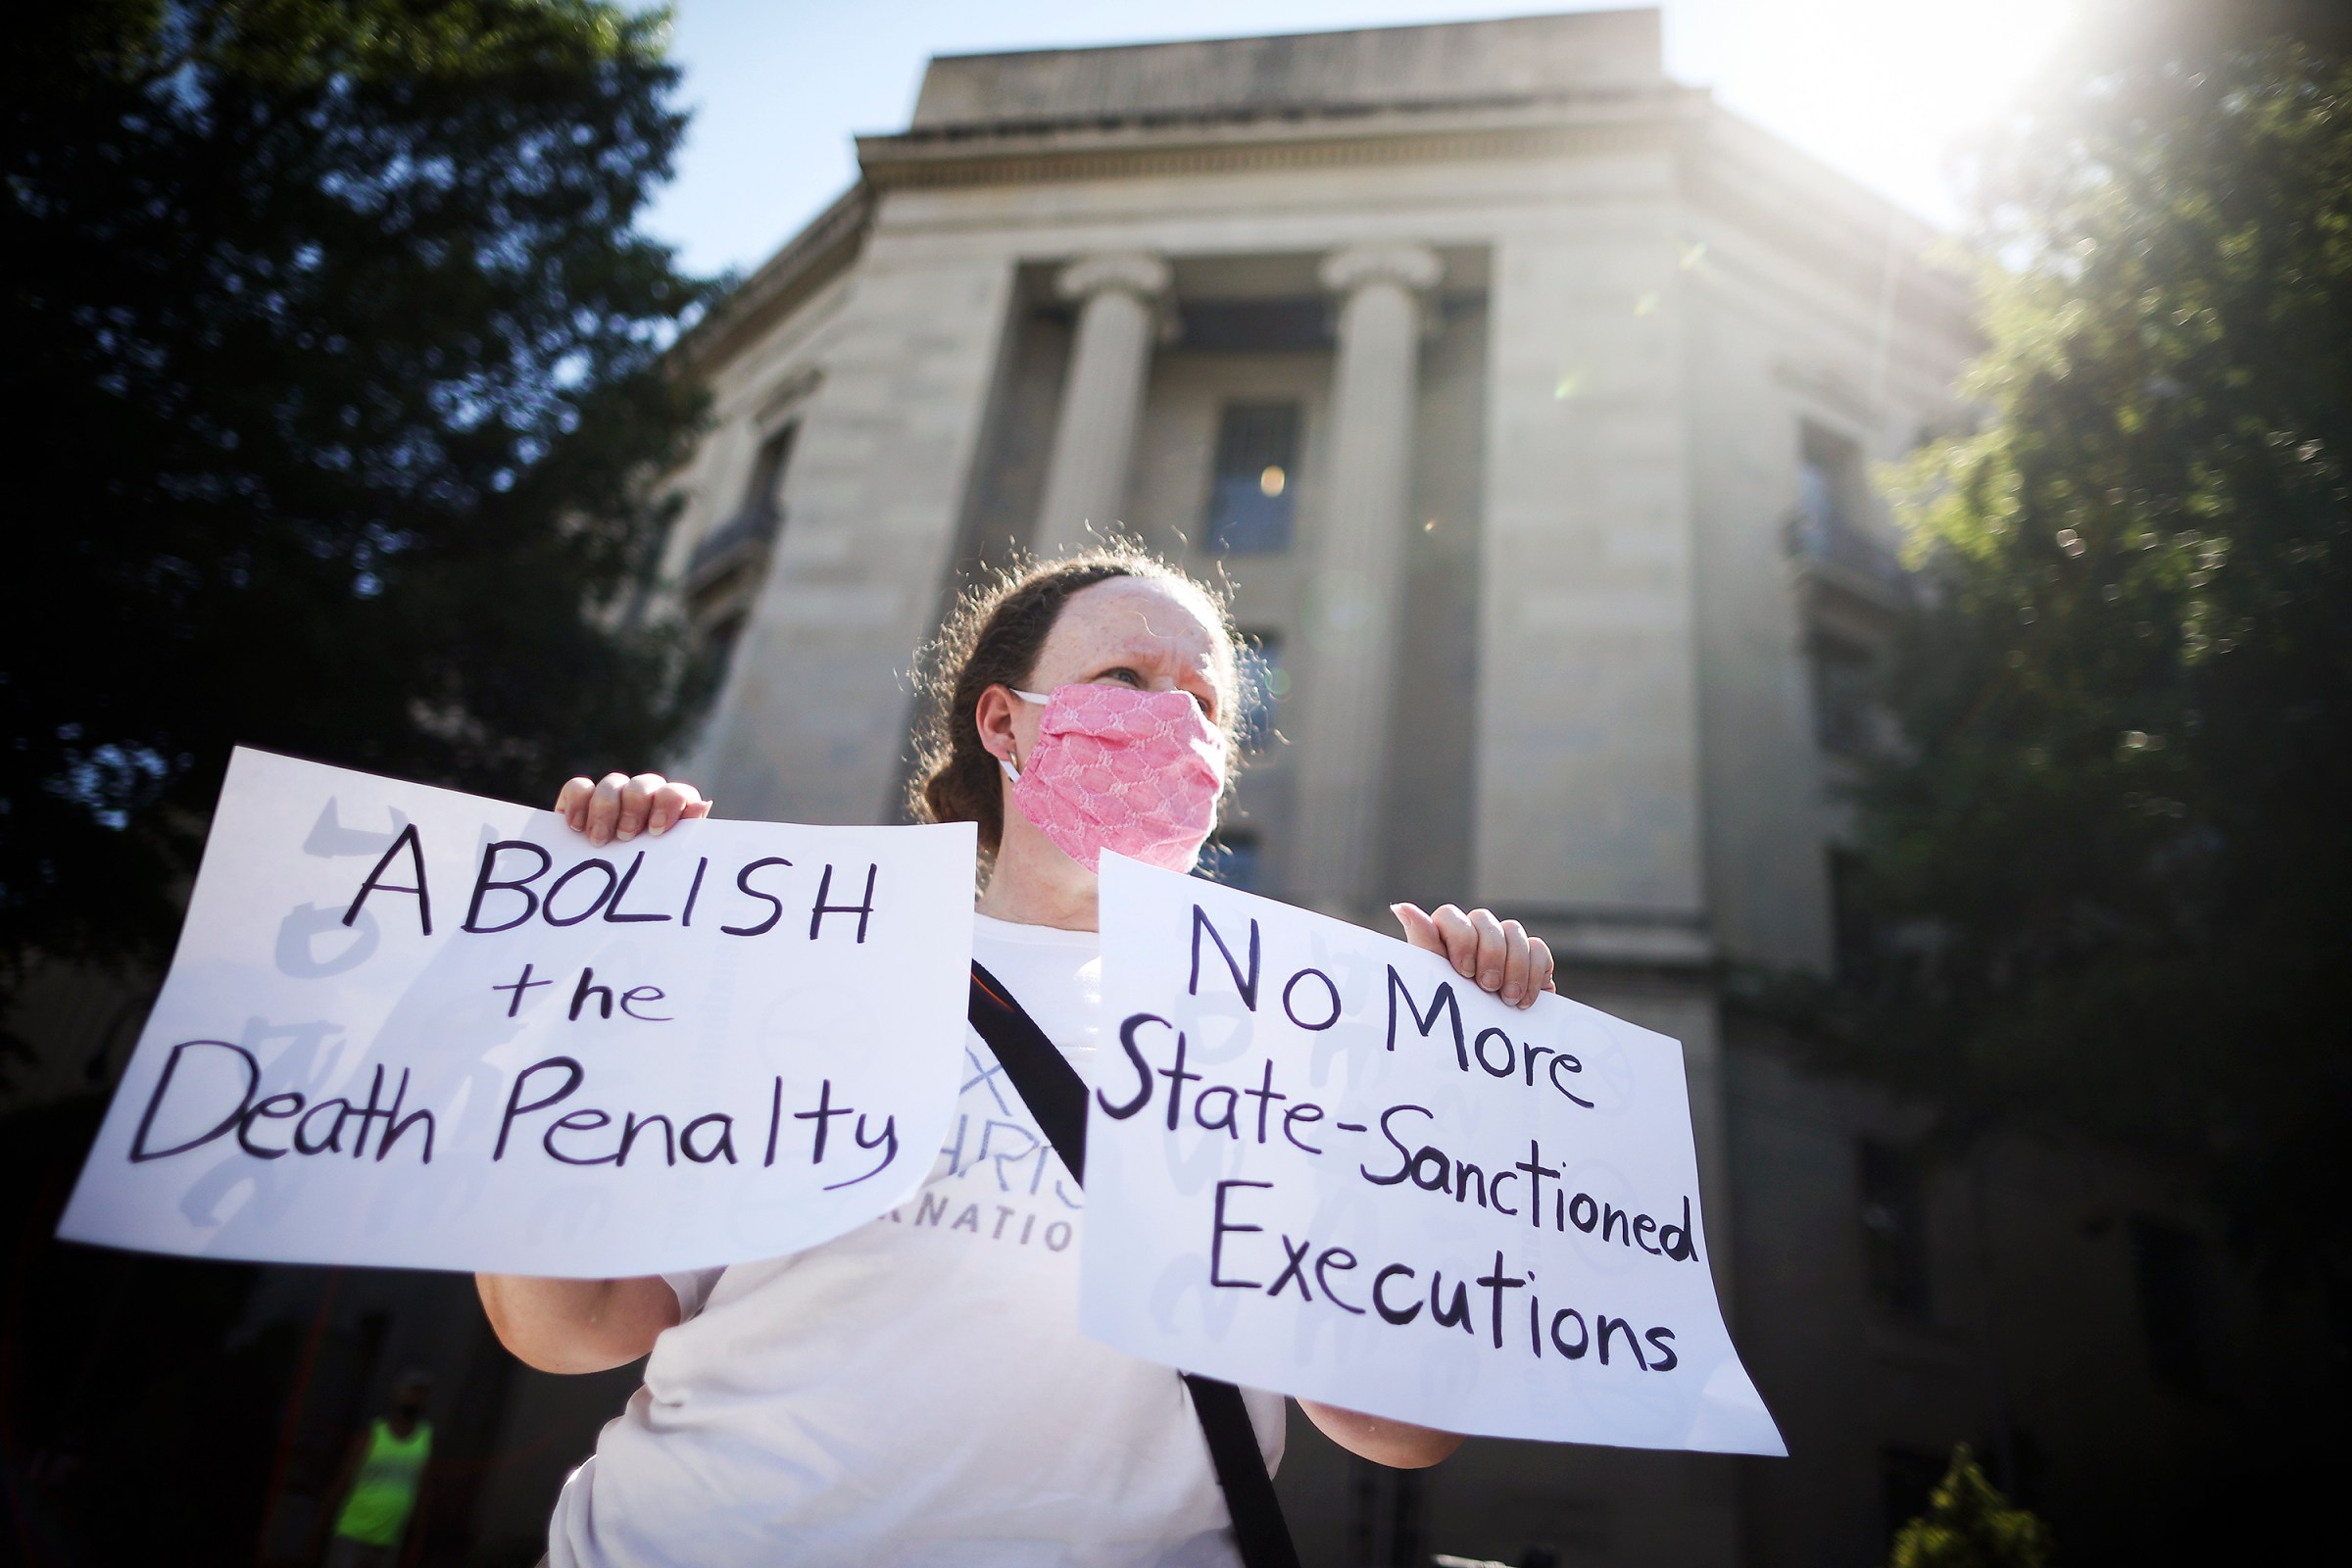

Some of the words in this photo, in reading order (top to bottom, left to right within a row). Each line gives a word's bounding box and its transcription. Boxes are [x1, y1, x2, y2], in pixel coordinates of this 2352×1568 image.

[341, 822, 879, 945] ABOLISH
[493, 963, 675, 1023] the
[1189, 903, 1343, 1032] No
[1387, 963, 1596, 1109] More
[128, 1039, 436, 1166] Death
[493, 1055, 900, 1191] Penalty
[1097, 1012, 1700, 1264] State-Sanctioned
[1209, 1179, 1679, 1373] Executions
